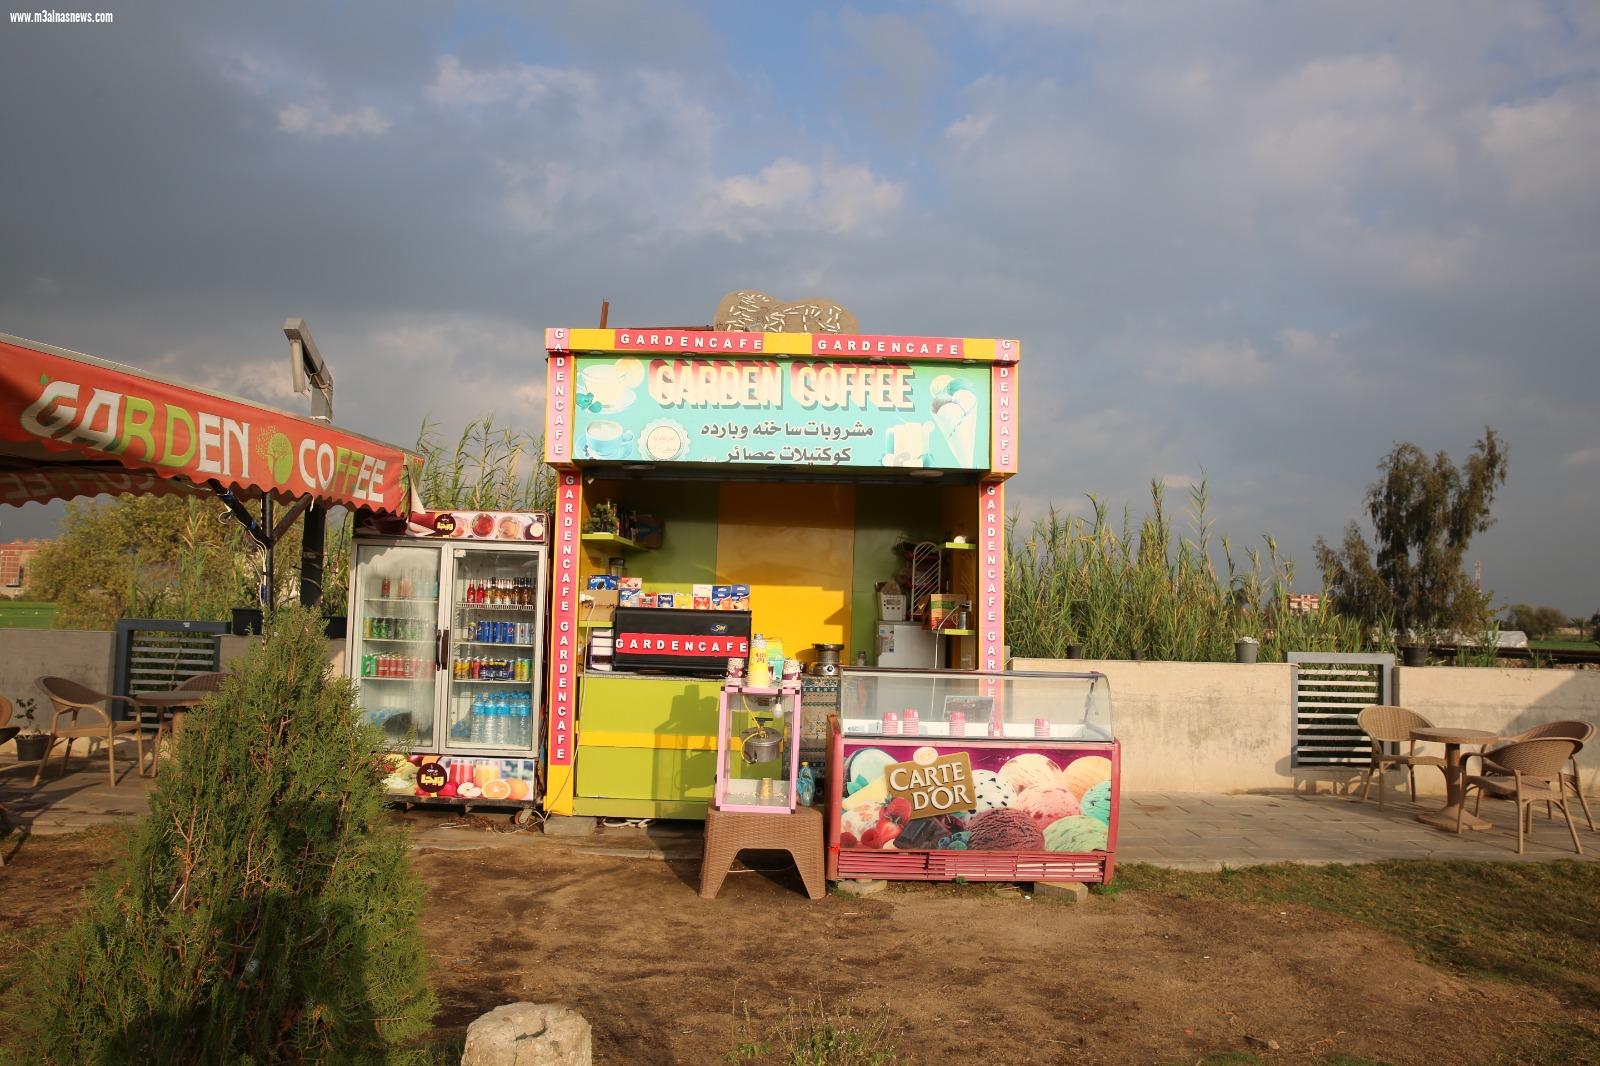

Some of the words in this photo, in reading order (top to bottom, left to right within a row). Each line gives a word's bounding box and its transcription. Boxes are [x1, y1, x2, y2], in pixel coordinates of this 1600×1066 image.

[620, 333, 763, 351] GARDENCAFE
[816, 339, 960, 355] GARDENCAFE
[651, 360, 784, 409] GARDEN
[792, 361, 915, 411] COFFEE
[20, 380, 251, 479] GARDEN
[298, 437, 386, 503] COFFEE
[808, 420, 874, 441] مشروبات
[779, 446, 851, 466] كوكتيلات
[561, 475, 575, 611] GARDENCAFE
[986, 486, 997, 621] GARDENCAFE
[615, 638, 748, 653] GARDENCAFE
[557, 621, 570, 760] GARDENCAFE
[888, 761, 966, 791] CARTE
[911, 784, 973, 811] D'OR
